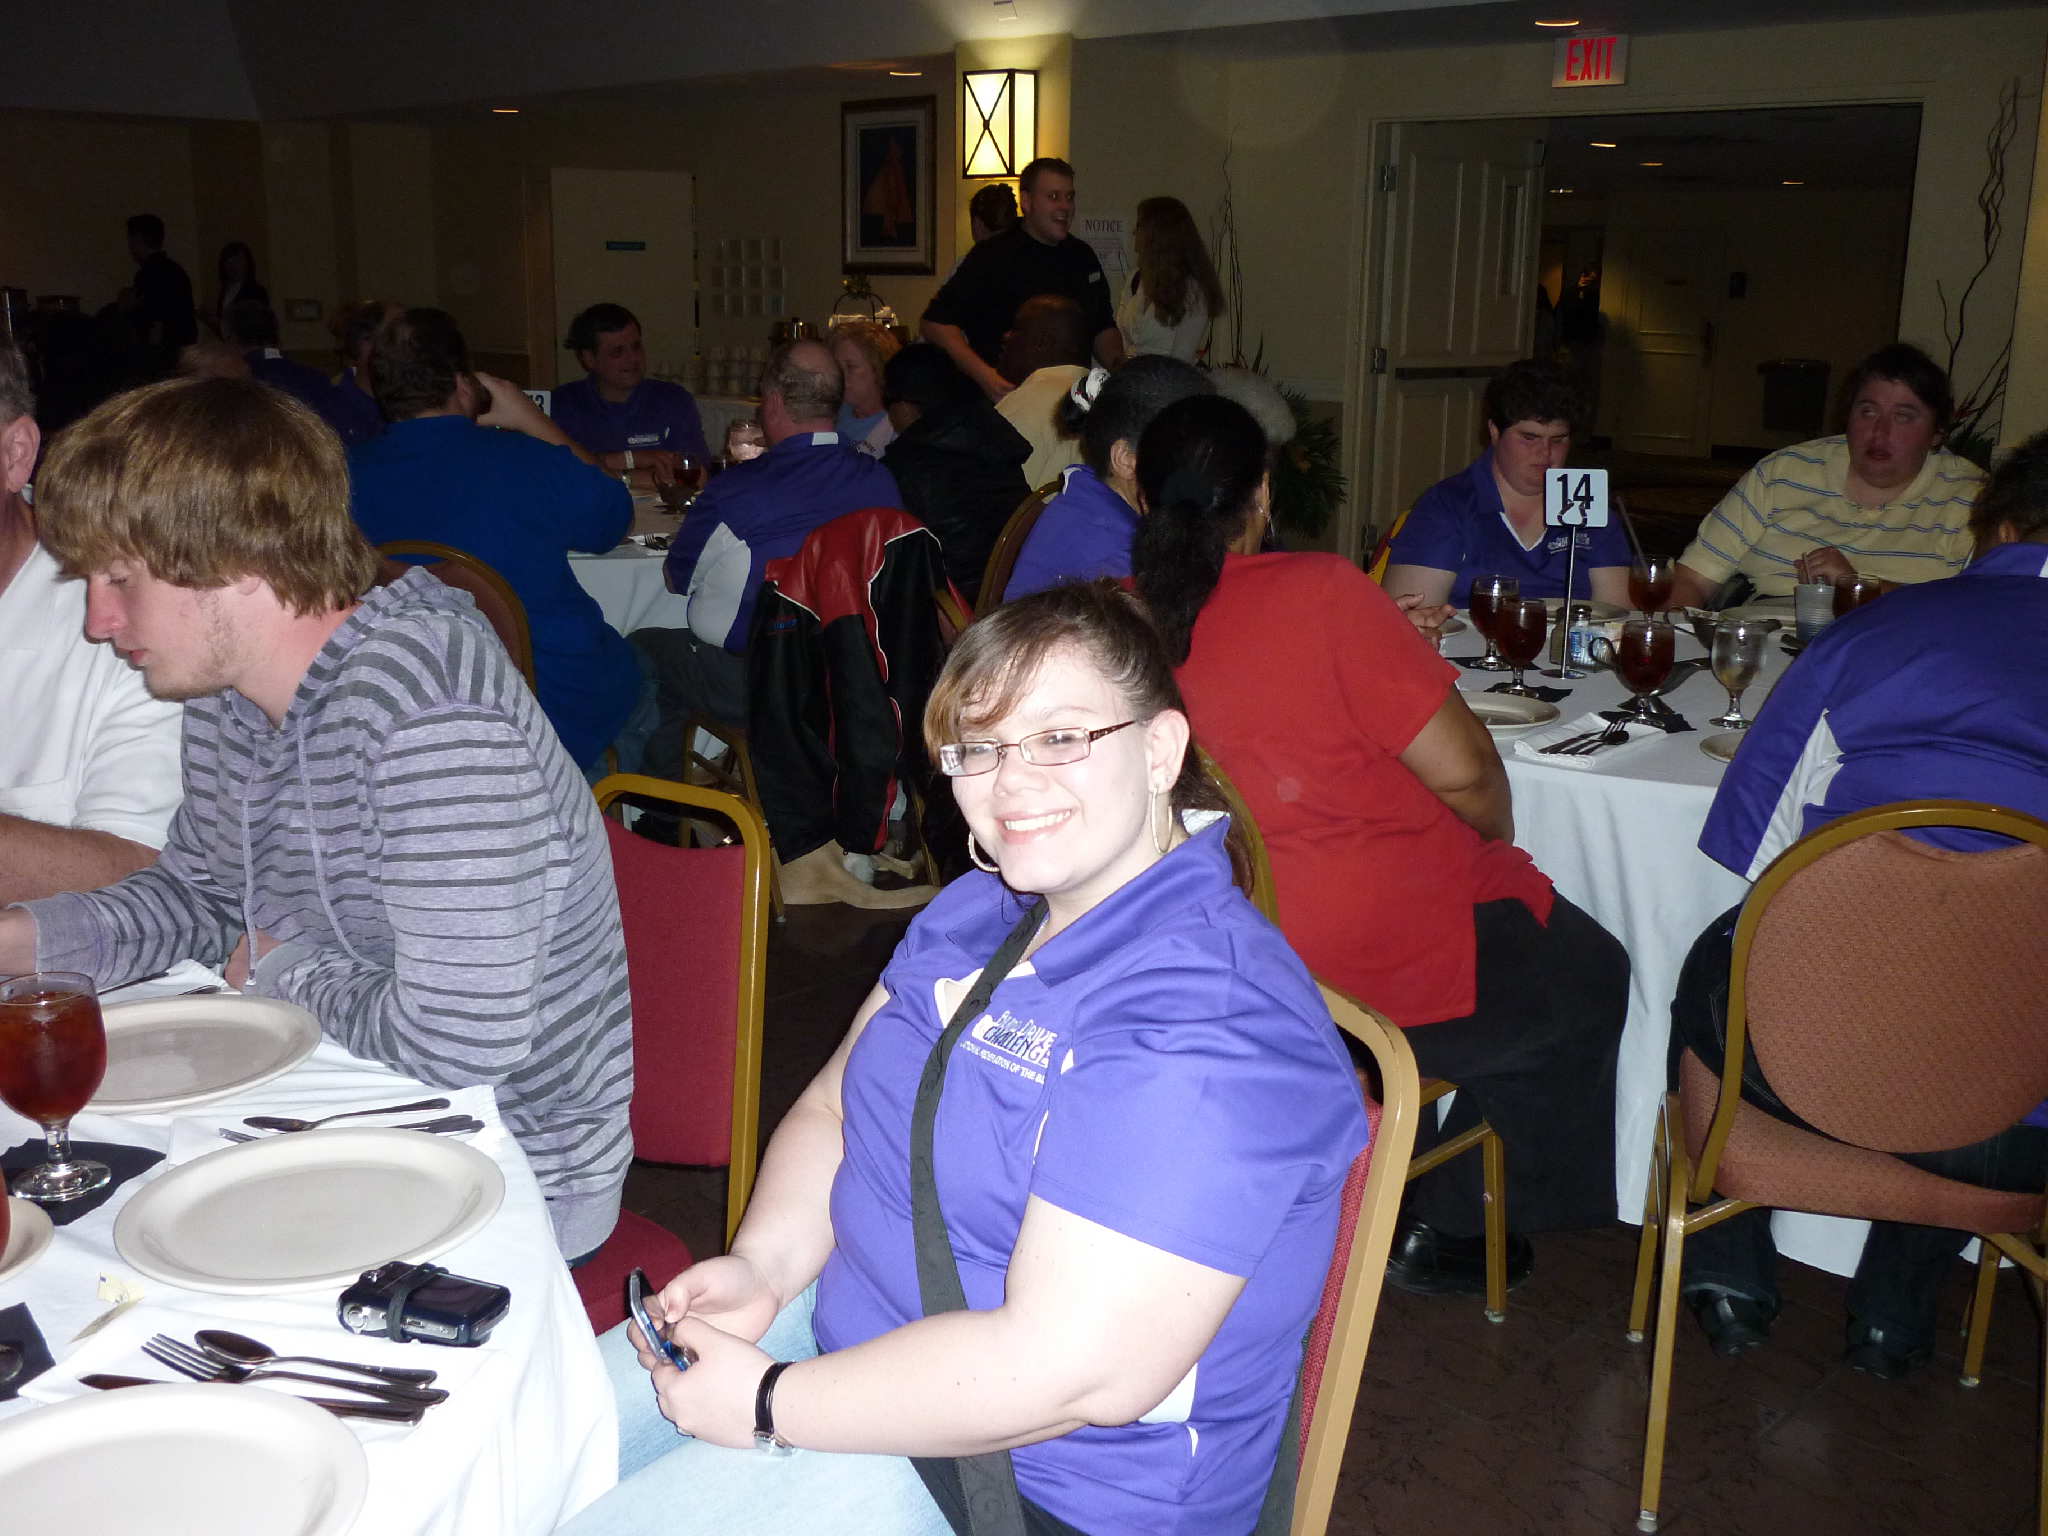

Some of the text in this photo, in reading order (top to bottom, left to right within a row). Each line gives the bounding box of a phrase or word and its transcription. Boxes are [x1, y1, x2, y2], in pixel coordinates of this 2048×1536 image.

[1566, 36, 1617, 81] EXIT
[1085, 219, 1123, 232] NOTICE
[1557, 473, 1594, 509] 14
